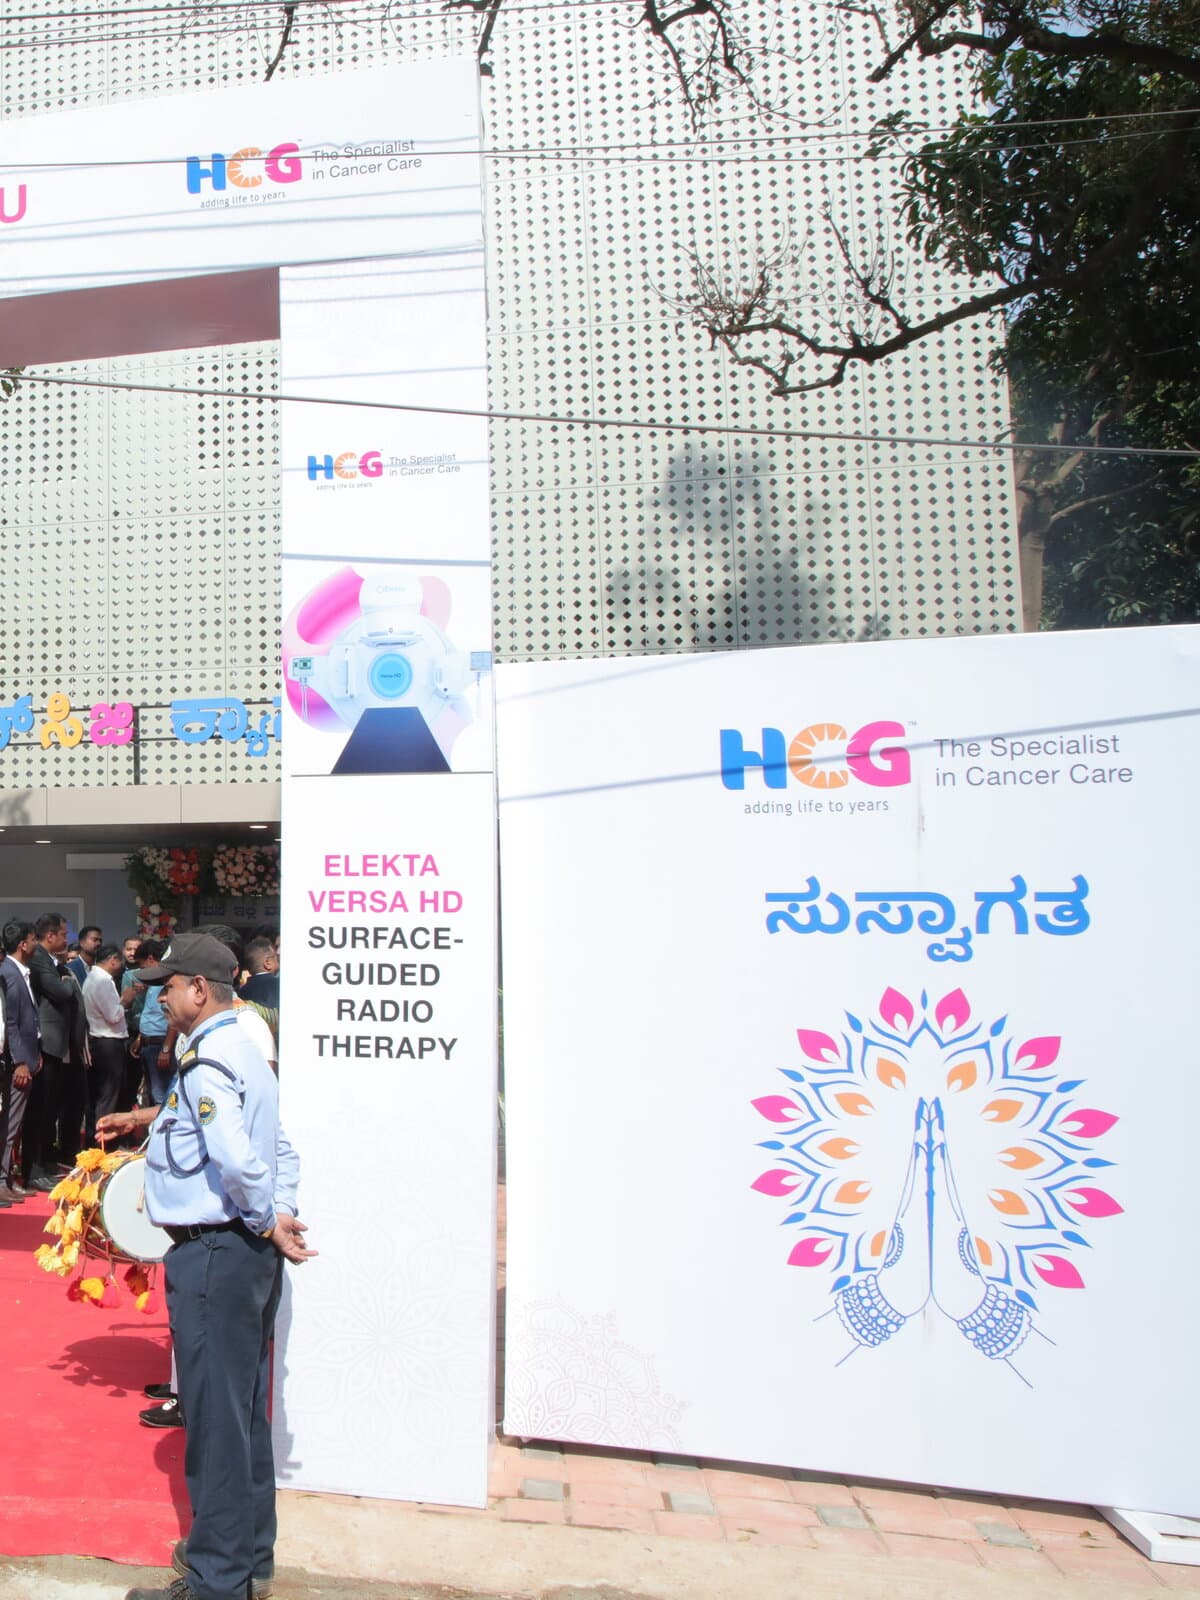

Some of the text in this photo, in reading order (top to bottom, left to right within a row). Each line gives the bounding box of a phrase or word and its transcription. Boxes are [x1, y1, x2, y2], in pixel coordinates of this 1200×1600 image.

[312, 139, 415, 163] The Specialist
[186, 142, 302, 194] HCG
[312, 156, 422, 180] in Cancer Care
[200, 191, 286, 208] adding life to years
[307, 451, 383, 480] HCG
[390, 453, 456, 466] The Specialist
[390, 465, 460, 476] in Cancer Care
[720, 721, 911, 791] HCG
[933, 734, 1119, 760] The Specialist
[936, 764, 1133, 787] in Cancer Care
[744, 799, 889, 816] adding life to years
[324, 855, 440, 877] ELEKTA
[308, 891, 463, 913] VERSA HD
[765, 874, 1091, 963] ಸುಸ್ವಾಗತ
[308, 927, 463, 950] SURFACE-
[322, 963, 440, 986] GUIDED
[337, 999, 433, 1023] RADIO
[313, 1034, 457, 1060] THERAPY
